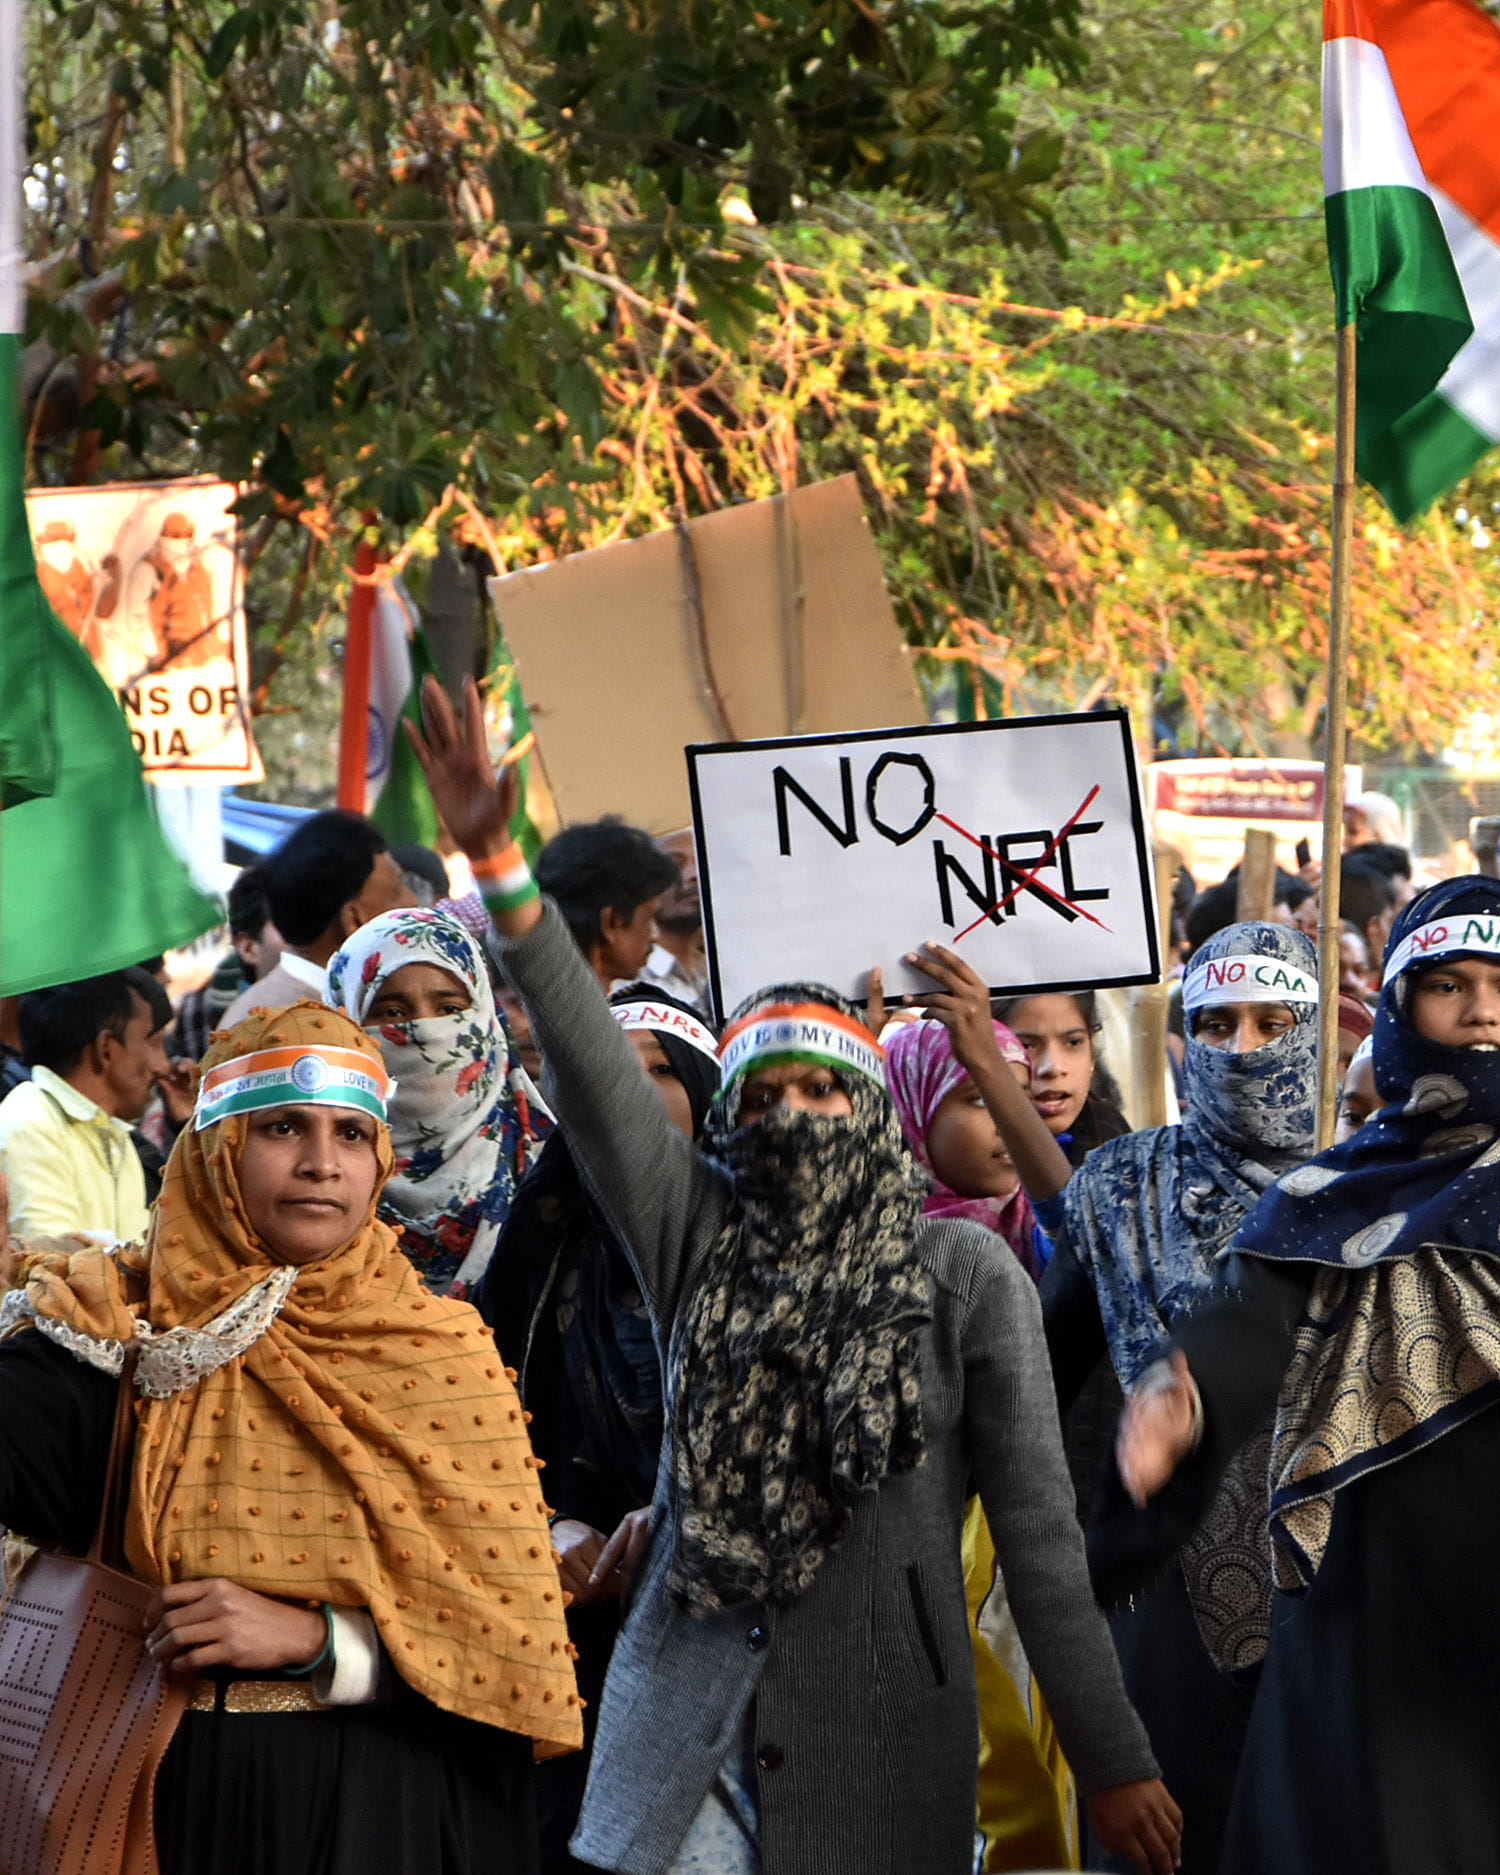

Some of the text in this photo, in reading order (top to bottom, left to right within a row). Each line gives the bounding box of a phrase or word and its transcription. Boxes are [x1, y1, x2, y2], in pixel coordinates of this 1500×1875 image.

[772, 751, 937, 856] NO
[932, 820, 1110, 928] NRC
[1410, 926, 1448, 958] NO
[1204, 961, 1247, 991] NO
[802, 1024, 832, 1046] MY
[343, 1071, 367, 1089] LOVE
